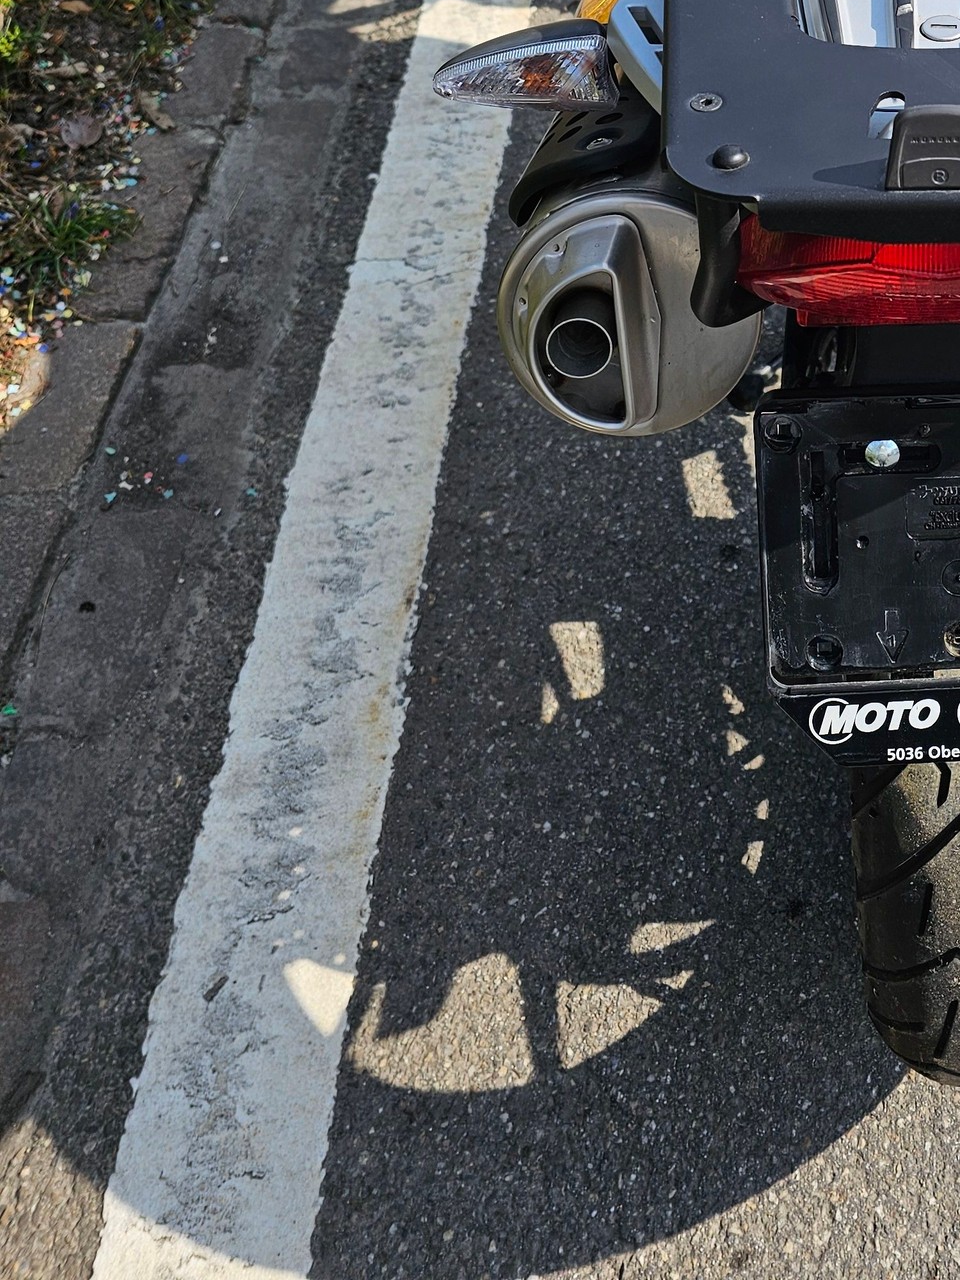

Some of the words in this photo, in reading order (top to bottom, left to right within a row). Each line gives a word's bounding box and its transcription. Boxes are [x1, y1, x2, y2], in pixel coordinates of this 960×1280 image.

[886, 634, 897, 648] 1
[818, 698, 941, 736] MOTO
[886, 746, 924, 762] 5036
